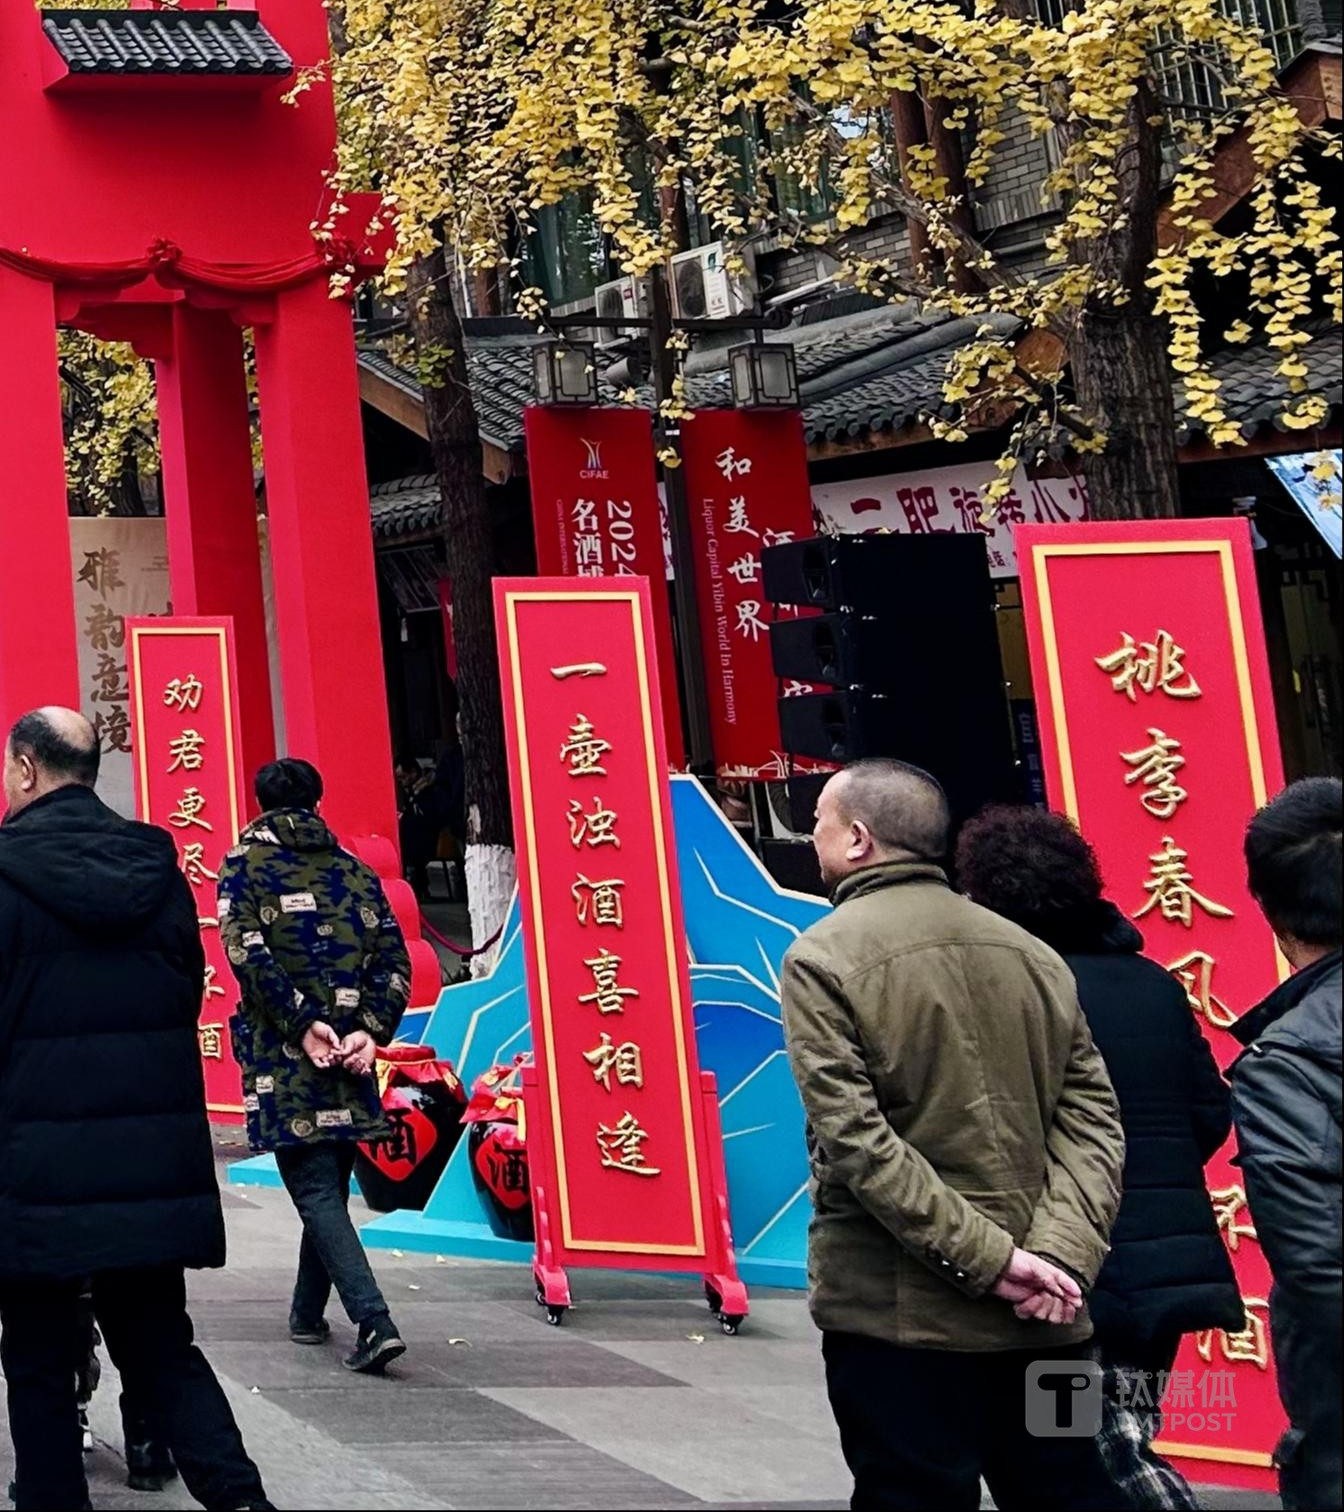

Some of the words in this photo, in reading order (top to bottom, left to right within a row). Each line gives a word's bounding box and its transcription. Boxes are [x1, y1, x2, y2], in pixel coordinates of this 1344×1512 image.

[579, 469, 609, 480] CIFAE
[701, 497, 715, 537] Liquor
[706, 539, 723, 580] Capital
[715, 446, 771, 642] 和美世界
[713, 581, 725, 613] Yibin
[717, 616, 732, 650] World
[720, 653, 732, 667] In
[722, 669, 737, 725] Harmony
[550, 661, 662, 1176] 一壶浊酒喜相逢
